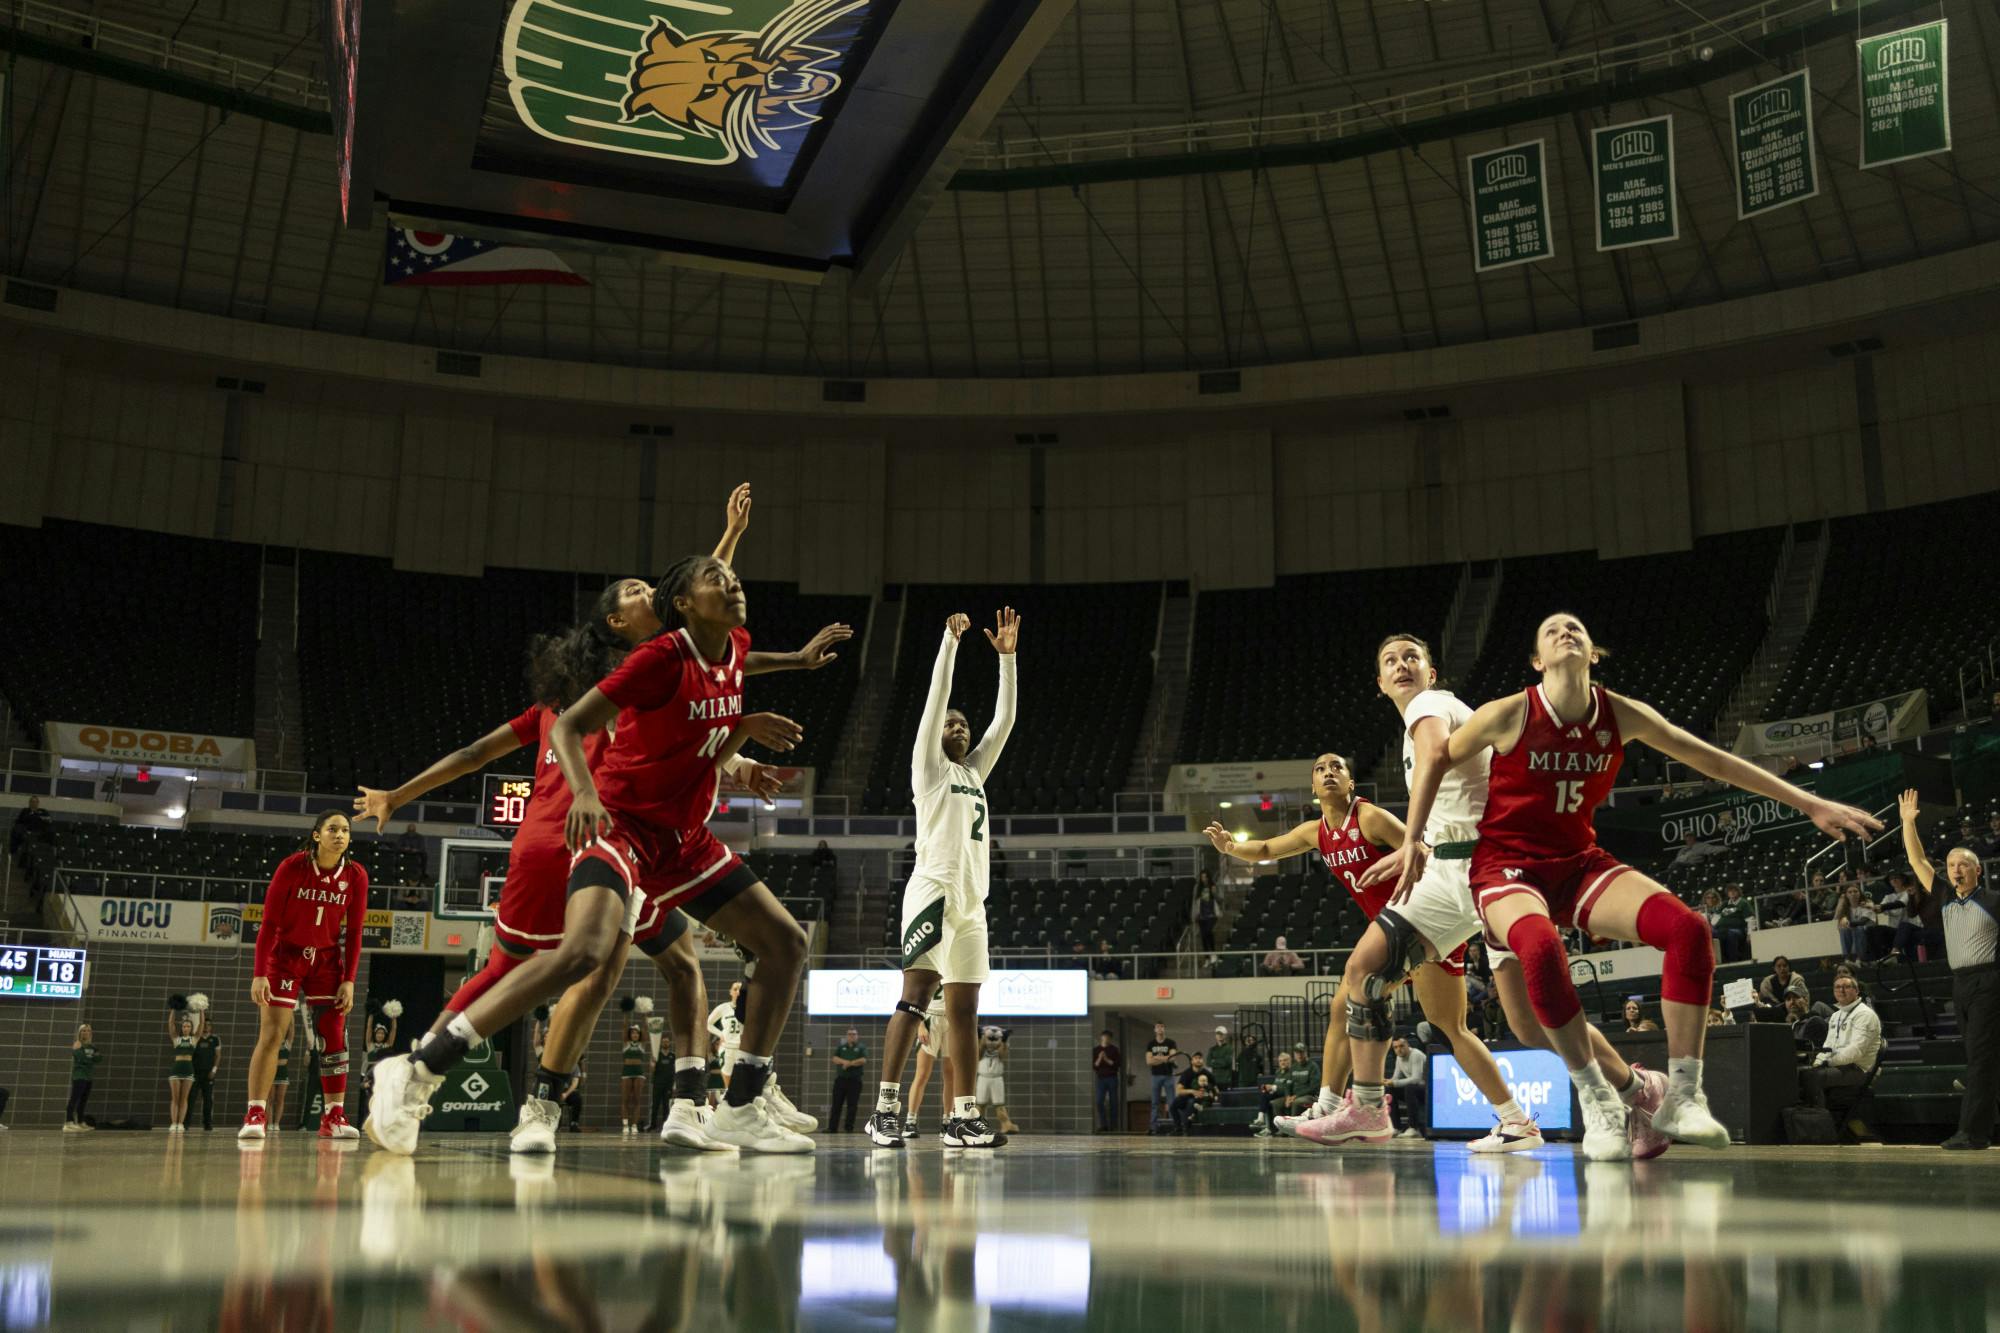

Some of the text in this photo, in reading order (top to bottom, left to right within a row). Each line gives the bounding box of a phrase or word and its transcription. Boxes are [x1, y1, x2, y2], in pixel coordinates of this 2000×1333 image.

[1878, 37, 1925, 71] OHIO
[1867, 83, 1939, 108] TOURNAMENT
[1889, 78, 1915, 92] MAC
[1748, 88, 1791, 125] OHIO
[1870, 95, 1935, 118] CHAMPIONS
[1872, 117, 1899, 132] 2021
[1611, 130, 1655, 162] OHIO
[1740, 131, 1804, 161] TOURNAMENT
[1761, 129, 1784, 143] MAC
[1745, 142, 1802, 171] CHAMPIONS
[1486, 154, 1528, 186] OHIO
[1606, 184, 1665, 203] CHAMPIONS
[1623, 178, 1646, 190] MAC
[1482, 204, 1537, 225] CHAMPIONS
[1499, 198, 1521, 211] MAC
[688, 694, 742, 721] MIAMI
[1791, 720, 1830, 738] Dean
[79, 727, 222, 757] QDOBA
[110, 749, 177, 761] MEXICAN
[1528, 750, 1614, 773] MIAMI
[502, 781, 531, 798] 1:45
[1555, 780, 1585, 813] 15
[493, 795, 525, 823] 30
[970, 802, 986, 842] 2
[1661, 813, 1717, 843] OHIO
[1724, 826, 1752, 846] Club
[1321, 845, 1369, 868] MIAMI
[1343, 870, 1364, 893] 2
[1502, 867, 1524, 881] M
[297, 886, 347, 905] MIAMI
[100, 899, 172, 928] OUCU
[314, 905, 325, 927] 1
[98, 929, 169, 940] FINANCIAL
[904, 921, 935, 956] OHIO
[48, 950, 76, 960] MIAMI
[49, 962, 75, 982] 18
[50, 985, 76, 995] FOULS
[280, 979, 295, 991] M
[442, 1100, 501, 1113] gomart
